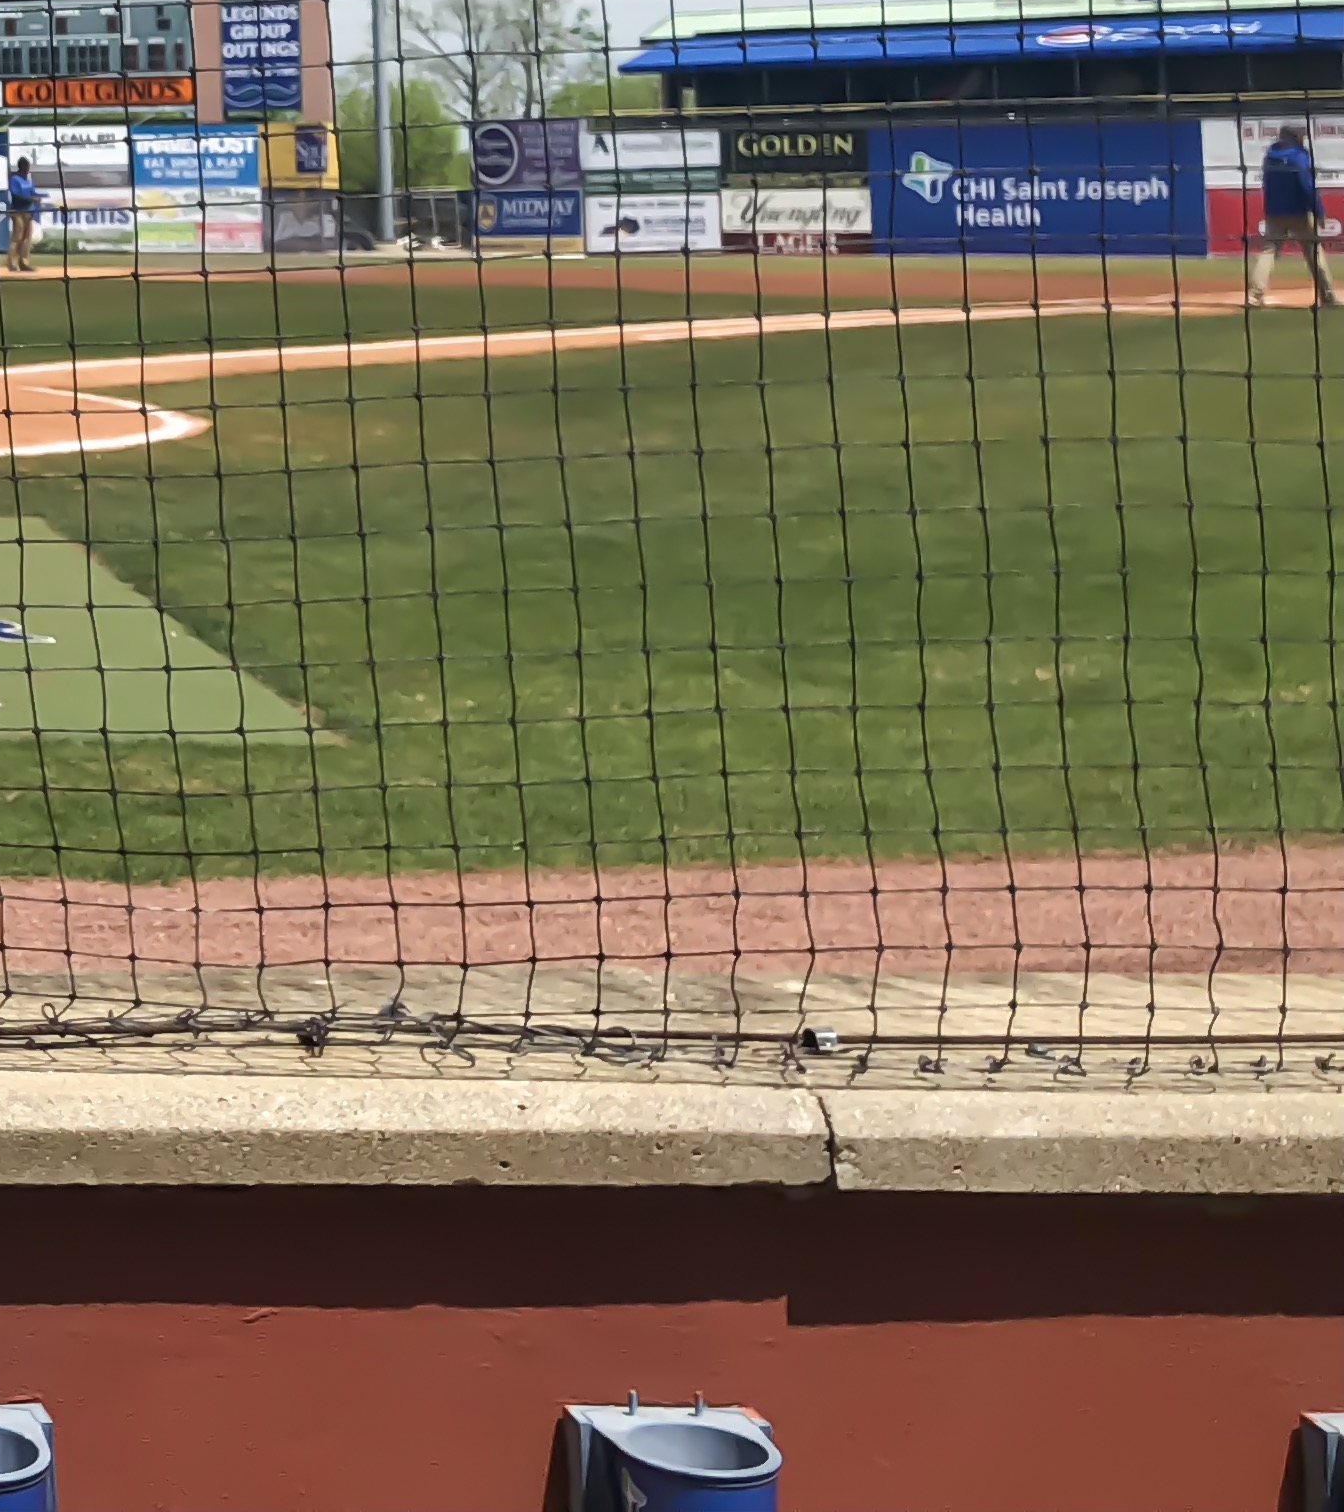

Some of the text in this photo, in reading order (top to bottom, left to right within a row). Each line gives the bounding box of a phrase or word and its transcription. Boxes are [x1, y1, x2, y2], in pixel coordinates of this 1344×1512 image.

[951, 175, 1170, 206] CHI Saint Joseph
[955, 202, 1042, 228] Health
